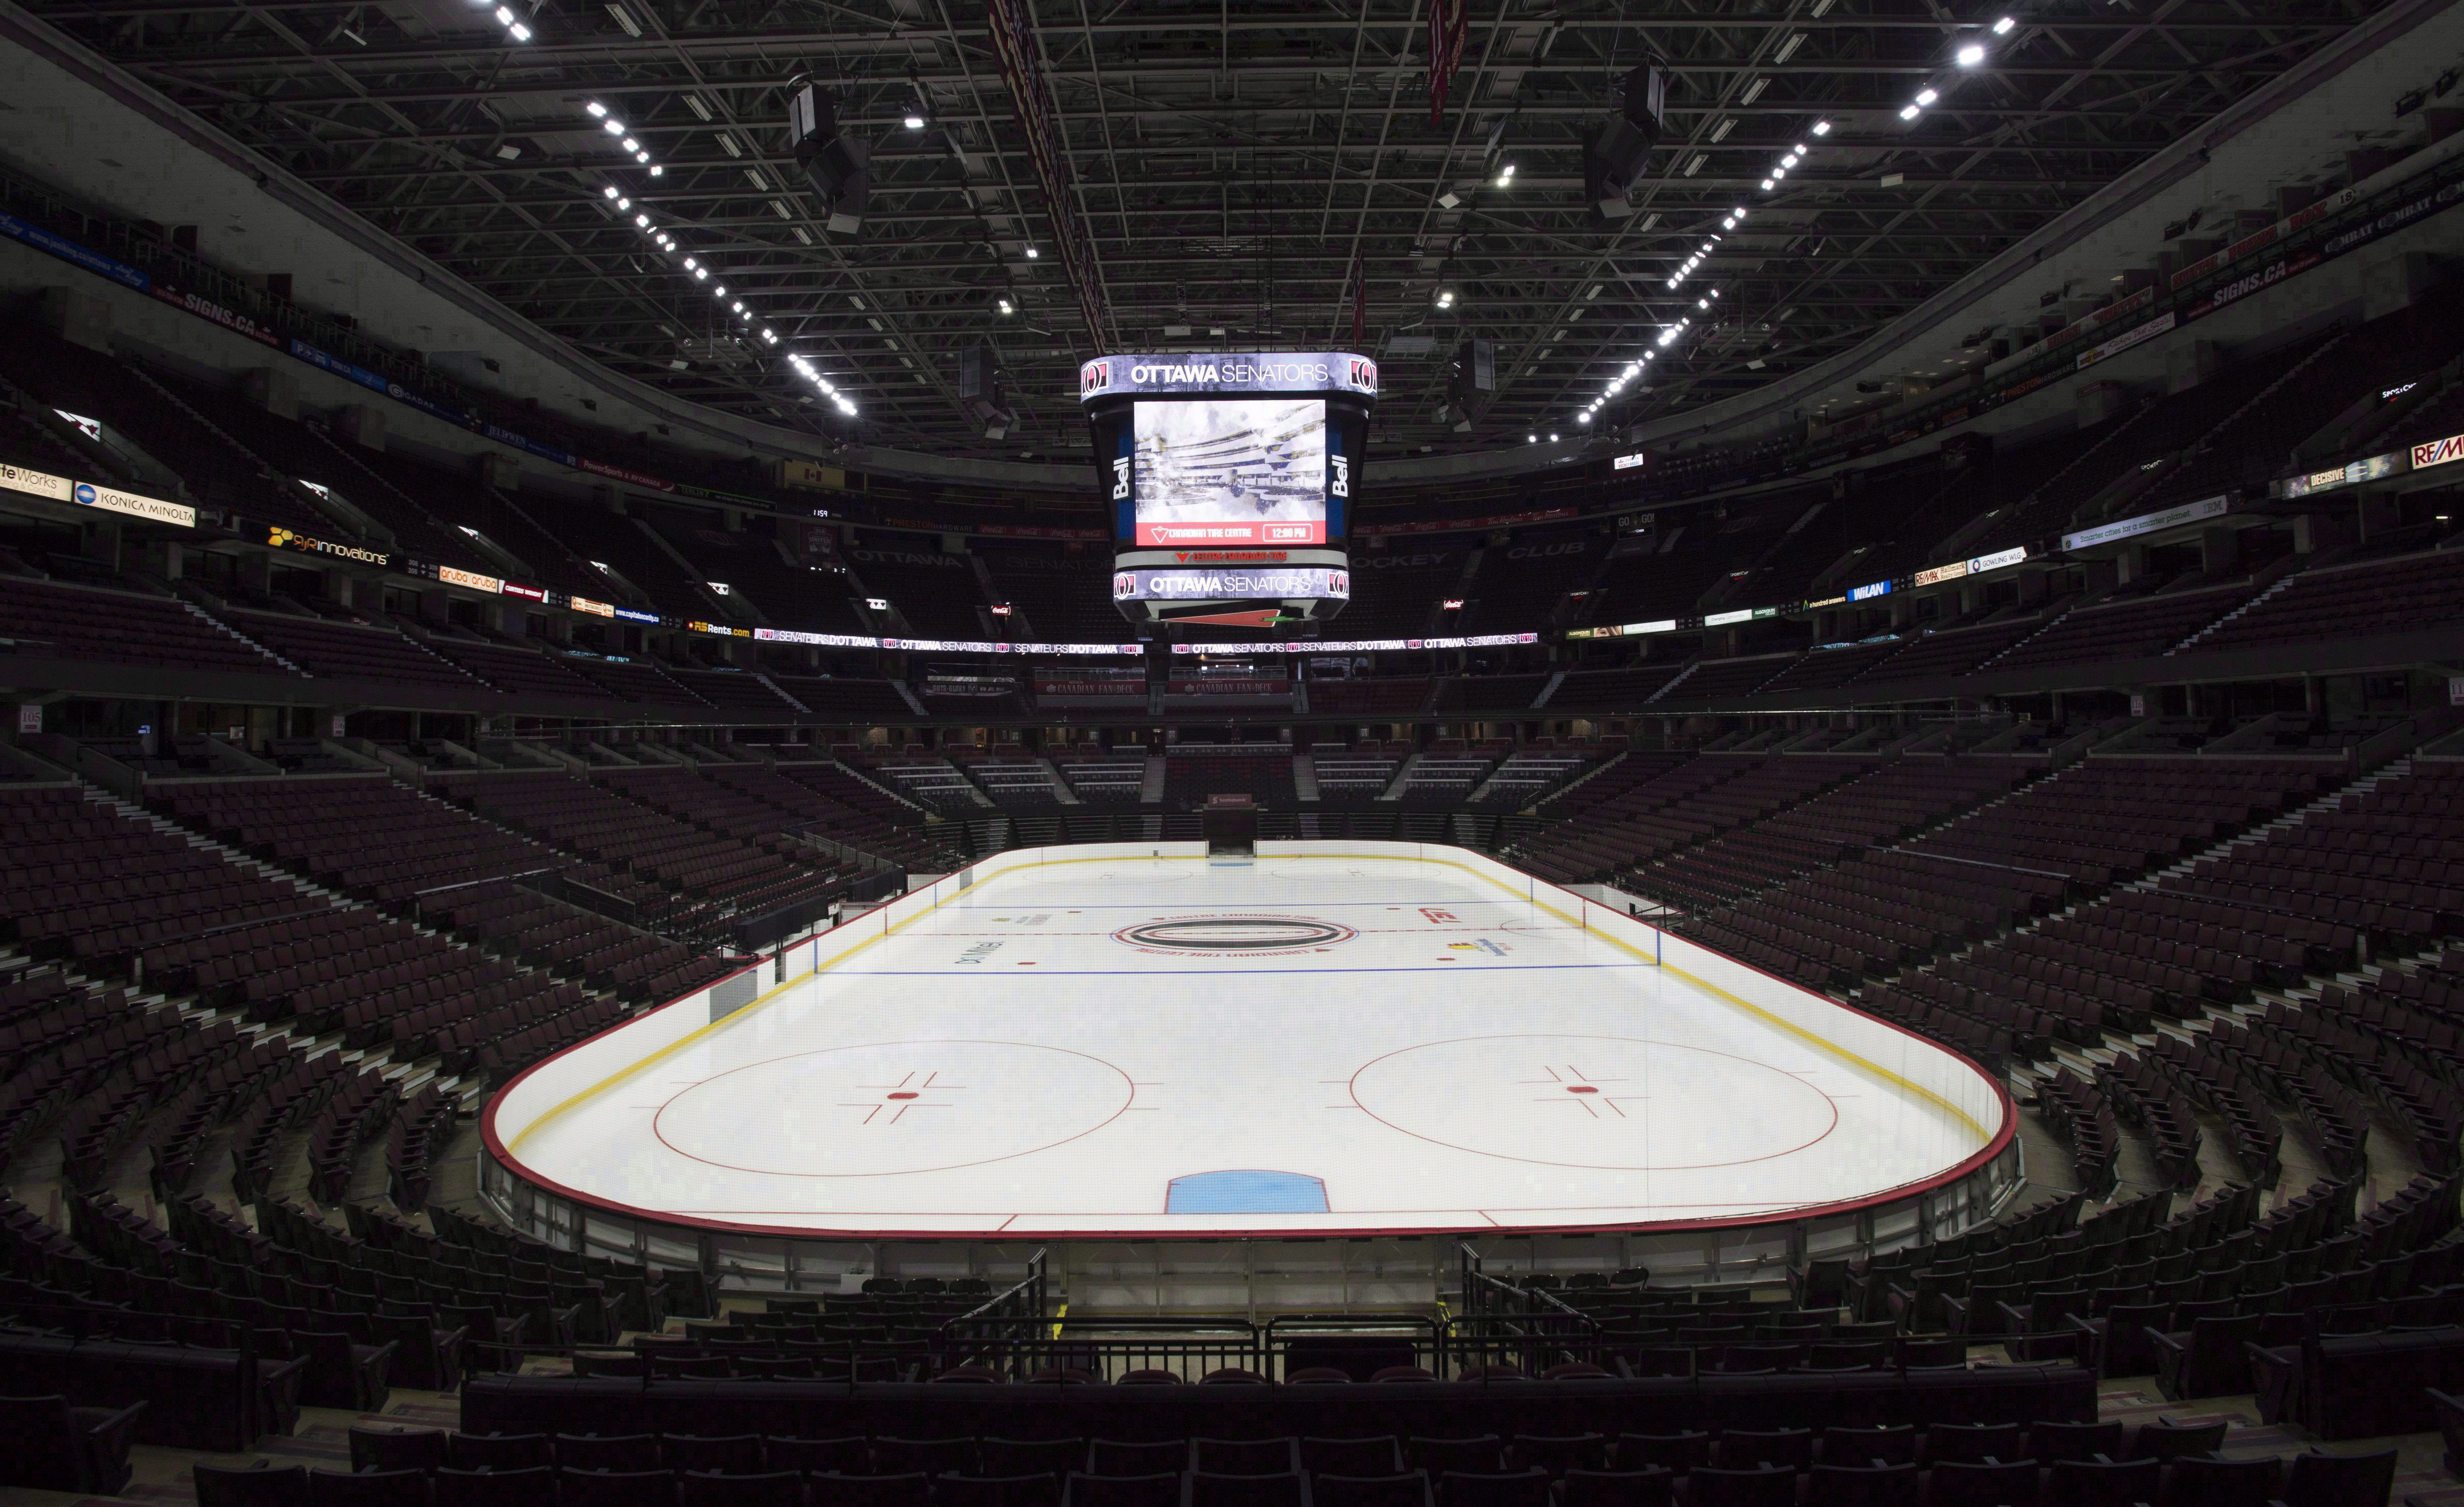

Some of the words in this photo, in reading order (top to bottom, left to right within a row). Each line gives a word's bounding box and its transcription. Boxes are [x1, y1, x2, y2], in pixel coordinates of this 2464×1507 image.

[2228, 225, 2277, 260] PRESS
[2289, 201, 2327, 232] BOX
[2340, 192, 2352, 204] 18
[2214, 261, 2286, 306] SIGNS.CA
[185, 293, 256, 336] SIGNS.CA
[1131, 365, 1219, 383] OTTAWA
[1222, 364, 1328, 382] SENATORS
[2007, 378, 2040, 398] PRESTON
[2040, 363, 2075, 383] HARDWARE
[404, 393, 435, 409] GADAR
[0, 465, 57, 489] teWorks
[584, 460, 622, 477] PowerSports
[639, 476, 661, 487] CANADA
[1113, 457, 1129, 500] Bell
[1332, 455, 1348, 497] Bell
[2311, 468, 2345, 486] DECISIVE
[101, 493, 145, 512] KONICA
[148, 505, 195, 523] MINOLTA
[893, 518, 933, 529] PRESTON
[933, 523, 973, 532] HARDWARE
[1488, 517, 1498, 525] Tim
[1500, 515, 1523, 524] Hortons
[1618, 516, 1630, 526] GO
[1641, 513, 1655, 523] GO!
[1169, 529, 1206, 538] CANADIAN
[1207, 529, 1223, 538] TIRE
[1225, 528, 1252, 537] CENTRE
[1294, 528, 1306, 538] PM
[2080, 531, 2103, 543] Smarter
[2104, 528, 2121, 537] cities
[2122, 524, 2131, 533] for
[2139, 517, 2165, 529] smarter
[1192, 552, 1222, 561] CENTRE
[1225, 552, 1268, 560] CANADIAN
[1269, 551, 1287, 560] TIRE
[1507, 542, 1585, 559] CLUB
[852, 550, 963, 568] OTTAWA
[1006, 557, 1115, 570] SENATOR
[1983, 556, 2007, 567] GOWLING
[2009, 552, 2021, 561] WLG
[441, 568, 467, 583] aruba
[1940, 563, 1965, 574] Hallmark
[472, 575, 496, 589] aruba
[1150, 577, 1222, 592] OTTAWA
[1225, 576, 1311, 592] SENATORS
[1916, 570, 1939, 585] RE/MAX
[1854, 582, 1884, 600] WiLAN
[1812, 598, 1828, 607] hundred
[1828, 596, 1846, 606] answers
[779, 631, 828, 645] SENATEURS
[829, 635, 877, 647] D'OTTAWA
[900, 640, 942, 650] OTTAWA
[943, 642, 992, 651] SENATORS
[1303, 641, 1356, 651] SENATEURS
[1357, 640, 1406, 650] D'OTTAWA
[1424, 638, 1466, 648] OTTAWA
[1467, 635, 1517, 646] SENATORS
[1015, 644, 1069, 653] SENATEURS
[1069, 645, 1117, 654] D'OTTAWA
[1192, 644, 1234, 653] OTTAWA
[1235, 643, 1284, 652] SENATORS
[1058, 684, 1094, 694] CANADIAN
[1099, 685, 1113, 694] FAN
[1117, 684, 1134, 694] DECK
[1197, 684, 1233, 693] CANADIAN
[1237, 684, 1251, 692] FAN
[1255, 684, 1273, 692] DECK
[22, 712, 41, 722] 105
